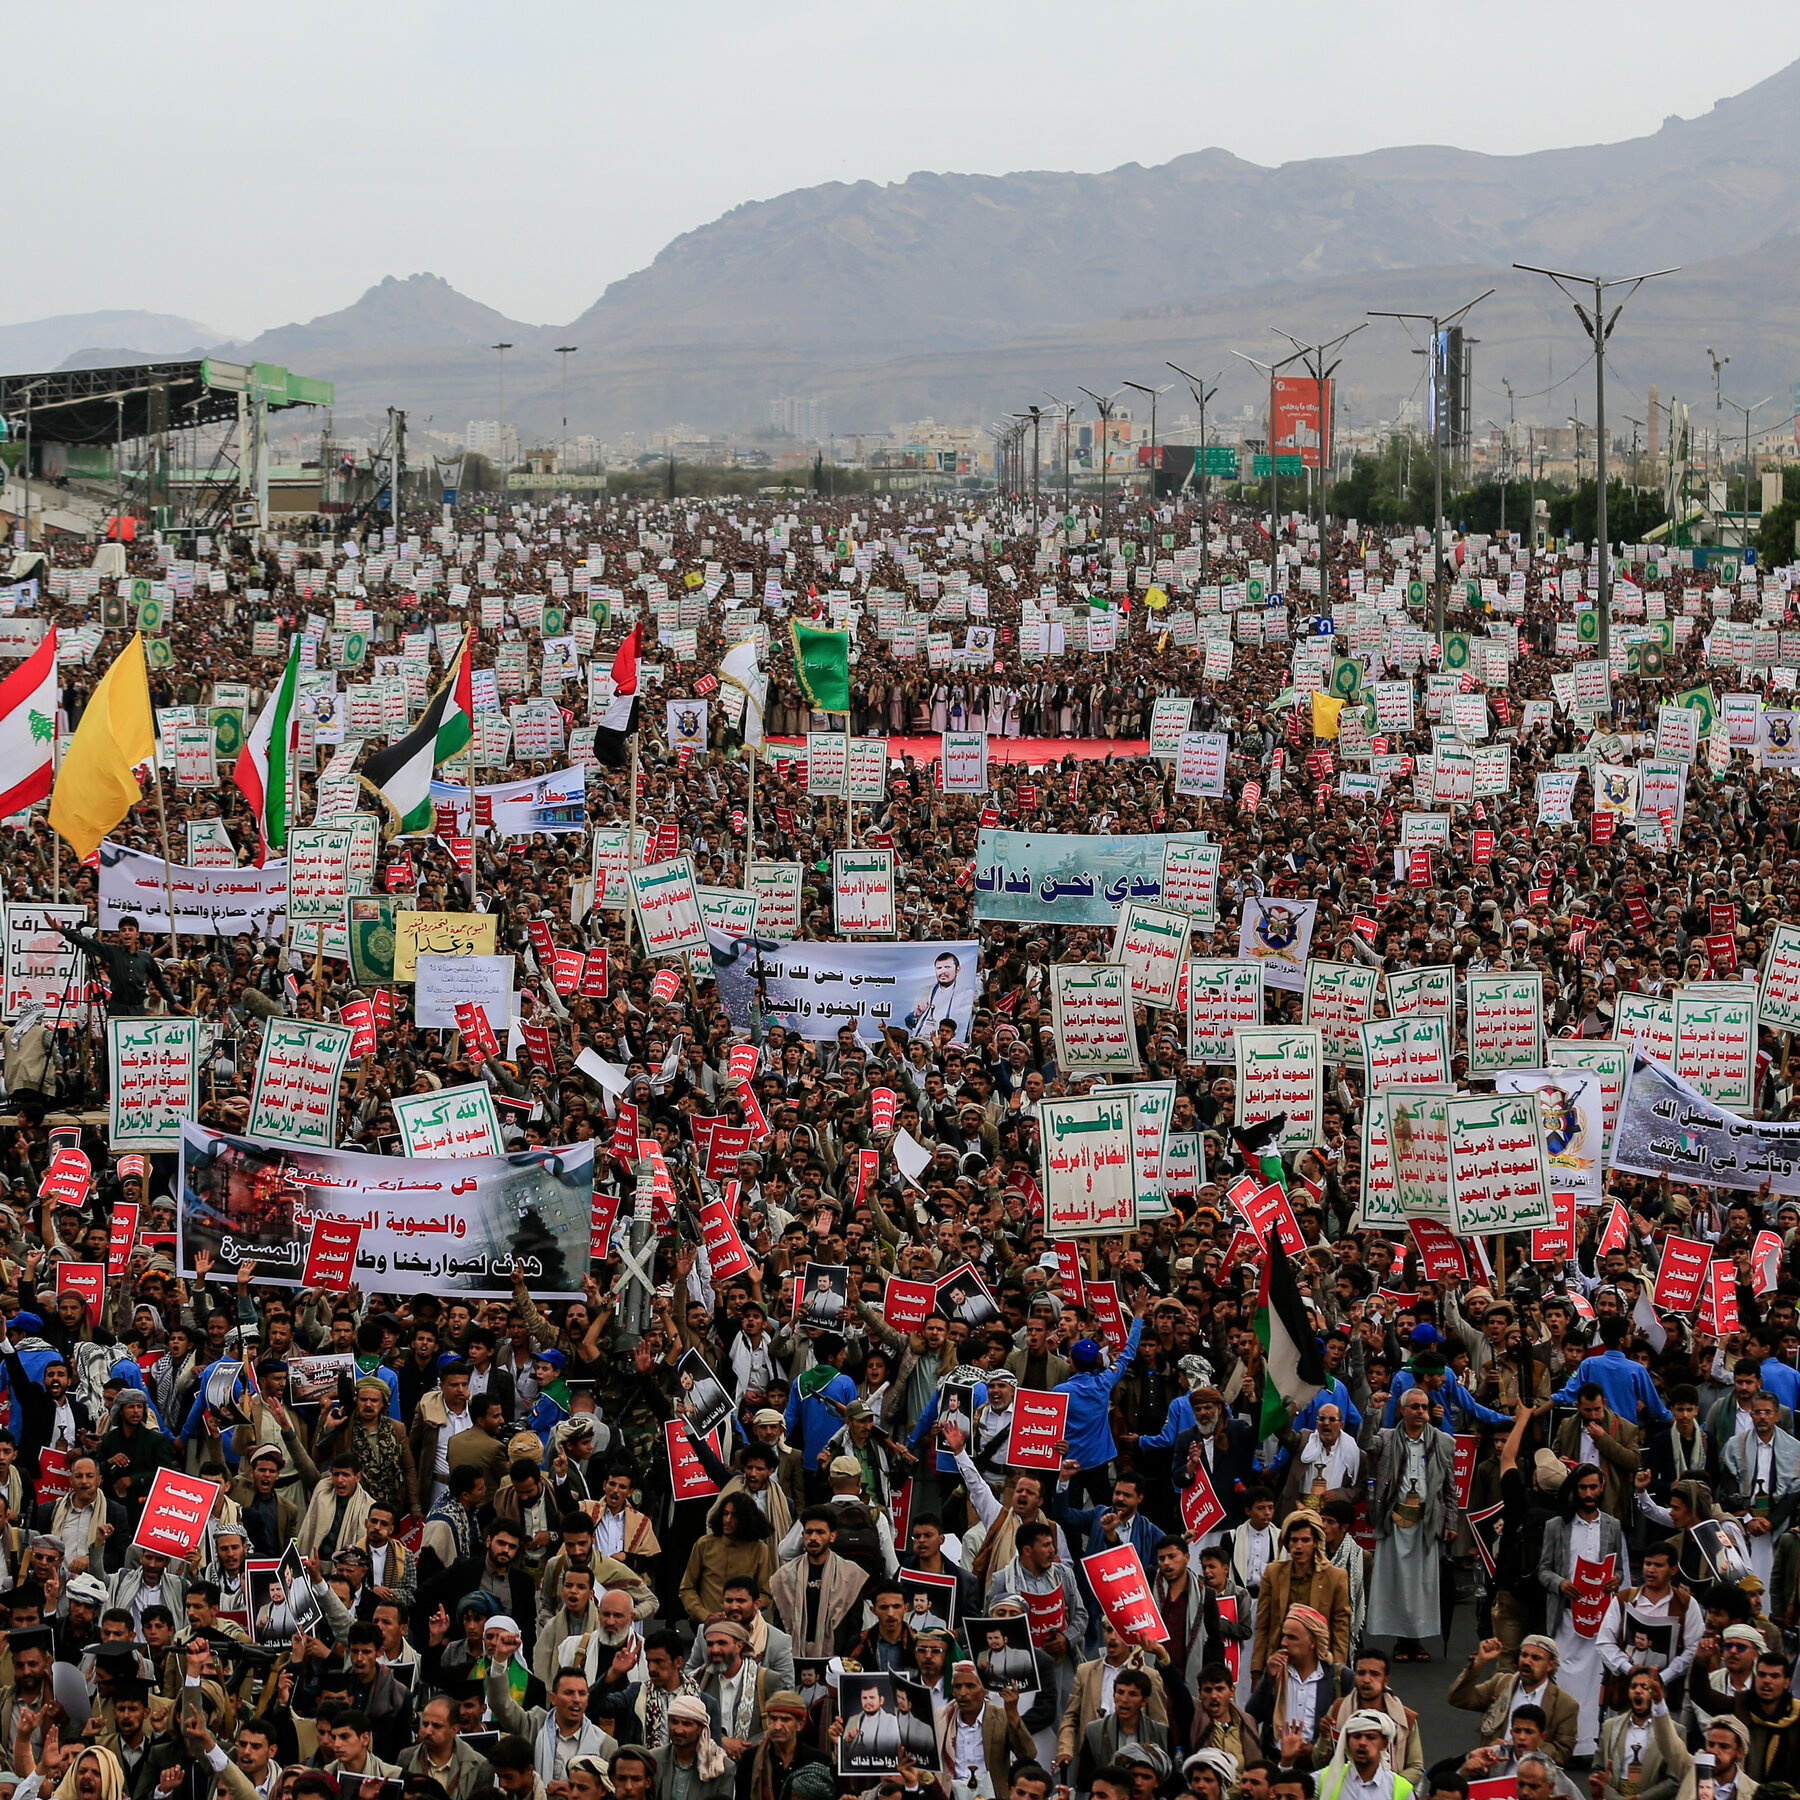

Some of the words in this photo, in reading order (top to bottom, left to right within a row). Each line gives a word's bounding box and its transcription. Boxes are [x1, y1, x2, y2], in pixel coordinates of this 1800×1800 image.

[1207, 736, 1221, 745] الله
[1644, 763, 1678, 776] قاطعوا
[538, 789, 567, 804] مطار
[1431, 823, 1444, 831] الله
[841, 856, 886, 875] قاطعوا
[135, 877, 159, 888] نفسه
[198, 878, 209, 894] أن
[634, 864, 688, 892] قاطعوا
[976, 865, 1031, 894] فداك
[213, 882, 261, 897] السعودي
[867, 880, 889, 895] البضائع
[1040, 872, 1094, 902] نحن
[1105, 875, 1161, 909] يدي
[668, 888, 692, 905] البضائع
[146, 902, 161, 918] في
[251, 906, 265, 918] عن
[467, 923, 487, 936] اليوم
[840, 914, 890, 930] الإسرائيلية
[1131, 913, 1184, 938] قاطعوا
[648, 922, 701, 944] الإسرائيلية
[12, 962, 55, 979] جبريل
[789, 965, 808, 979] لك
[815, 970, 843, 983] نحن
[850, 975, 895, 989] سيدي
[1062, 969, 1107, 993] أكبر
[1105, 972, 1121, 987] الله
[1476, 982, 1510, 1004] أكبر
[1513, 984, 1534, 999] الله
[817, 1001, 865, 1018] الجنود
[871, 1002, 891, 1018] لك
[1096, 996, 1121, 1008] الموت
[1510, 1004, 1535, 1017] الموت
[1680, 1004, 1722, 1027] أكبر
[1724, 1008, 1748, 1024] الله
[1097, 1015, 1123, 1027] الموت
[1510, 1022, 1535, 1034] الموت
[121, 1023, 162, 1051] أكبر
[165, 1025, 191, 1044] الله
[1066, 1033, 1088, 1044] اليهود
[1091, 1033, 1104, 1044] على
[1106, 1033, 1126, 1042] اللعنة
[1371, 1021, 1409, 1051] أكبر
[1413, 1022, 1439, 1041] الله
[1719, 1030, 1747, 1043] الموت
[316, 1033, 344, 1053] الله
[1475, 1036, 1497, 1049] اليهود
[1501, 1037, 1512, 1048] على
[1516, 1036, 1535, 1046] اللعنة
[1106, 1049, 1130, 1061] النصر
[1245, 1037, 1295, 1066] أكبر
[1294, 1041, 1313, 1059] الله
[1410, 1049, 1441, 1064] الموت
[1508, 1049, 1535, 1065] النصر
[1718, 1049, 1746, 1061] الموت
[160, 1052, 190, 1067] الموت
[308, 1061, 335, 1074] الموت
[1678, 1067, 1703, 1078] اليهود
[1707, 1067, 1720, 1079] على
[1724, 1067, 1746, 1078] اللعنة
[160, 1073, 189, 1089] الموت
[304, 1081, 332, 1095] الموت
[121, 1094, 145, 1110] اليهود
[148, 1094, 161, 1108] على
[166, 1093, 189, 1107] اللعنة
[260, 1093, 288, 1109] اليهود
[291, 1098, 303, 1112] على
[306, 1099, 329, 1116] اللعنة
[456, 1098, 485, 1119] الله
[1510, 1104, 1533, 1125] الله
[1652, 1100, 1677, 1119] الله
[410, 1100, 450, 1134] أكبر
[1050, 1105, 1123, 1141] قاطعوا
[1453, 1101, 1510, 1138] أكبر
[1680, 1105, 1723, 1131] سبيل
[295, 1119, 327, 1138] النصر
[456, 1123, 489, 1143] الموت
[1499, 1134, 1535, 1152] الموت
[1650, 1137, 1707, 1163] الموقف
[1094, 1144, 1130, 1170] البضائع
[1712, 1152, 1736, 1173] في
[1741, 1154, 1791, 1176] وتأثير
[1501, 1159, 1537, 1176] الموت
[284, 1167, 357, 1188] النفطية
[452, 1175, 477, 1195] كل
[1087, 1173, 1092, 1193] و
[1459, 1187, 1490, 1204] اليهود
[1493, 1186, 1511, 1201] على
[1515, 1183, 1540, 1195] اللعنة
[1053, 1199, 1132, 1225] الإسرائيلية
[1510, 1202, 1544, 1223] النصر
[386, 1211, 467, 1237] والحيوية
[321, 1230, 351, 1245] جمعة
[315, 1250, 349, 1261] التحذير
[1671, 1248, 1701, 1265] جمعة
[394, 1254, 487, 1278] لصواريخنا
[491, 1256, 542, 1278] هدف
[312, 1269, 344, 1281] والنفير
[1665, 1268, 1698, 1282] التحذير
[1662, 1288, 1692, 1301] والنفير
[1024, 1401, 1058, 1418] جمعة
[1019, 1423, 1057, 1436] التحذير
[1017, 1443, 1053, 1458] والنفير
[165, 1482, 203, 1504] جمعة
[155, 1505, 199, 1523] التحذير
[148, 1526, 189, 1547] والنفير
[1100, 1563, 1137, 1582] جمعة
[1112, 1585, 1146, 1612] التحذير
[1124, 1612, 1156, 1634] والنفير
[851, 1756, 870, 1766] فداك
